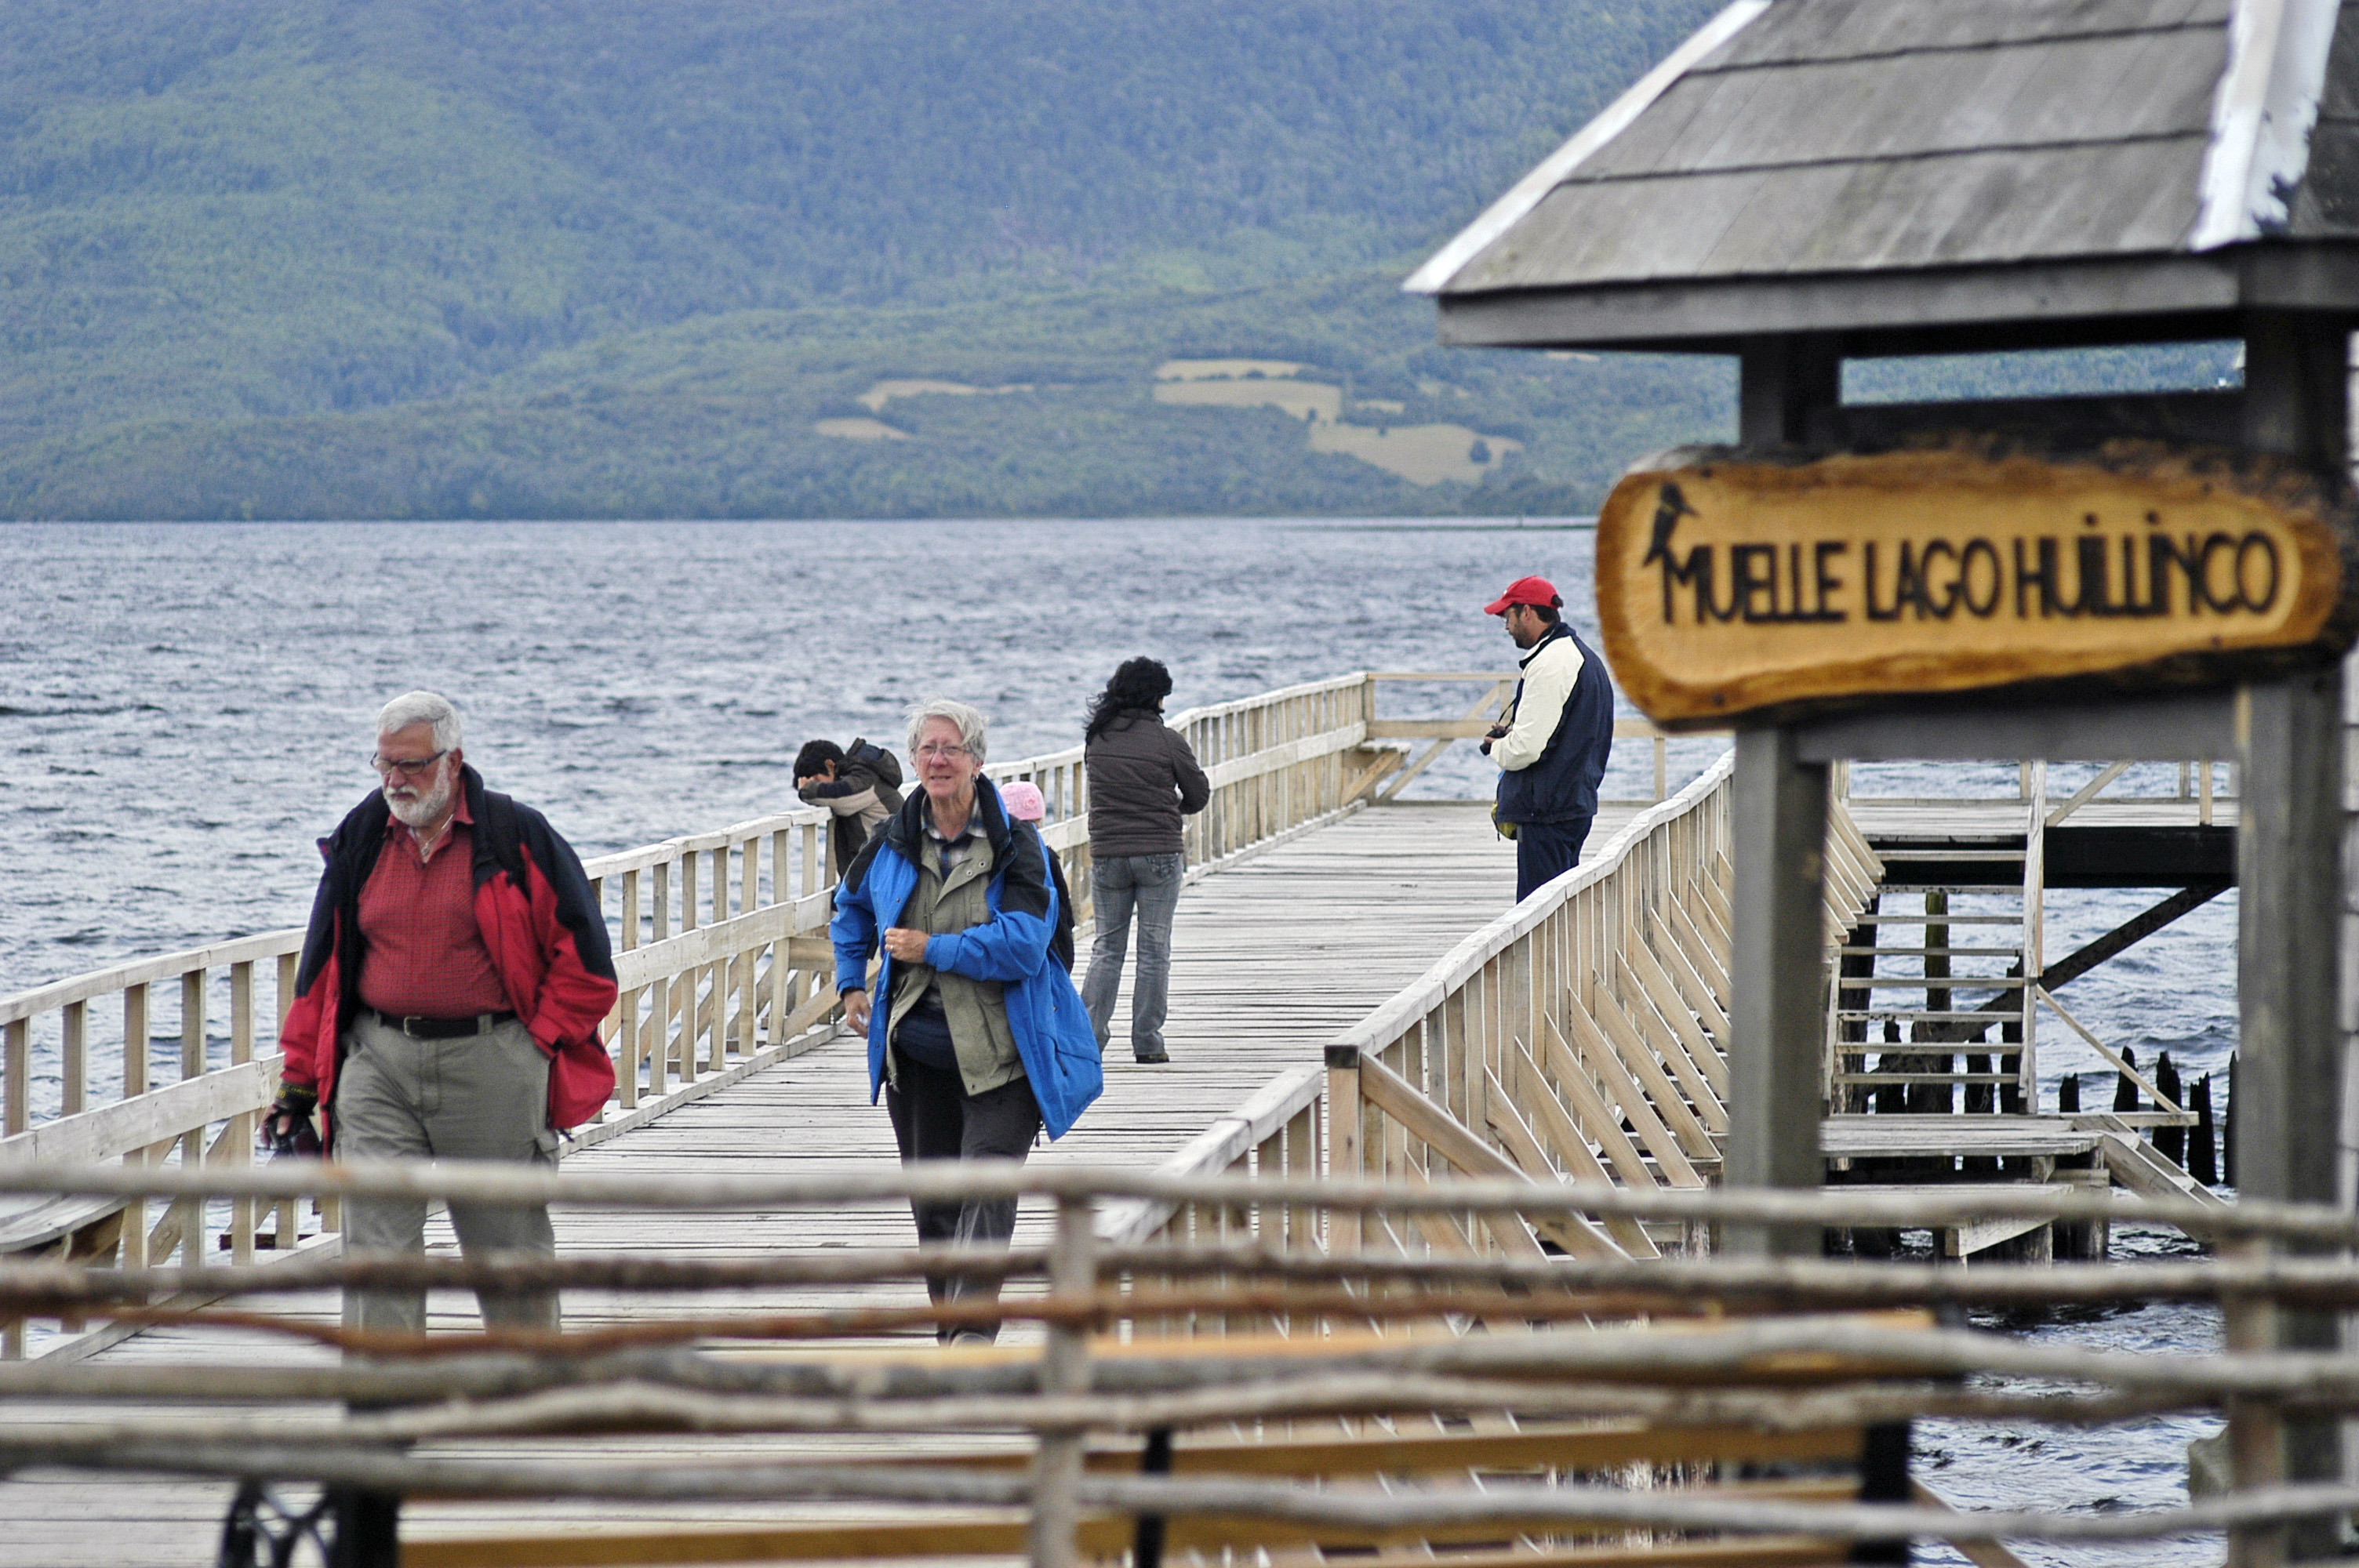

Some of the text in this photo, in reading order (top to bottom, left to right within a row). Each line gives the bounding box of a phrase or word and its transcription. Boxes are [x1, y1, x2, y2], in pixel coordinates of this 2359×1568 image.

[1661, 512, 2278, 624] MUELLE LAGO HUILLINCO
